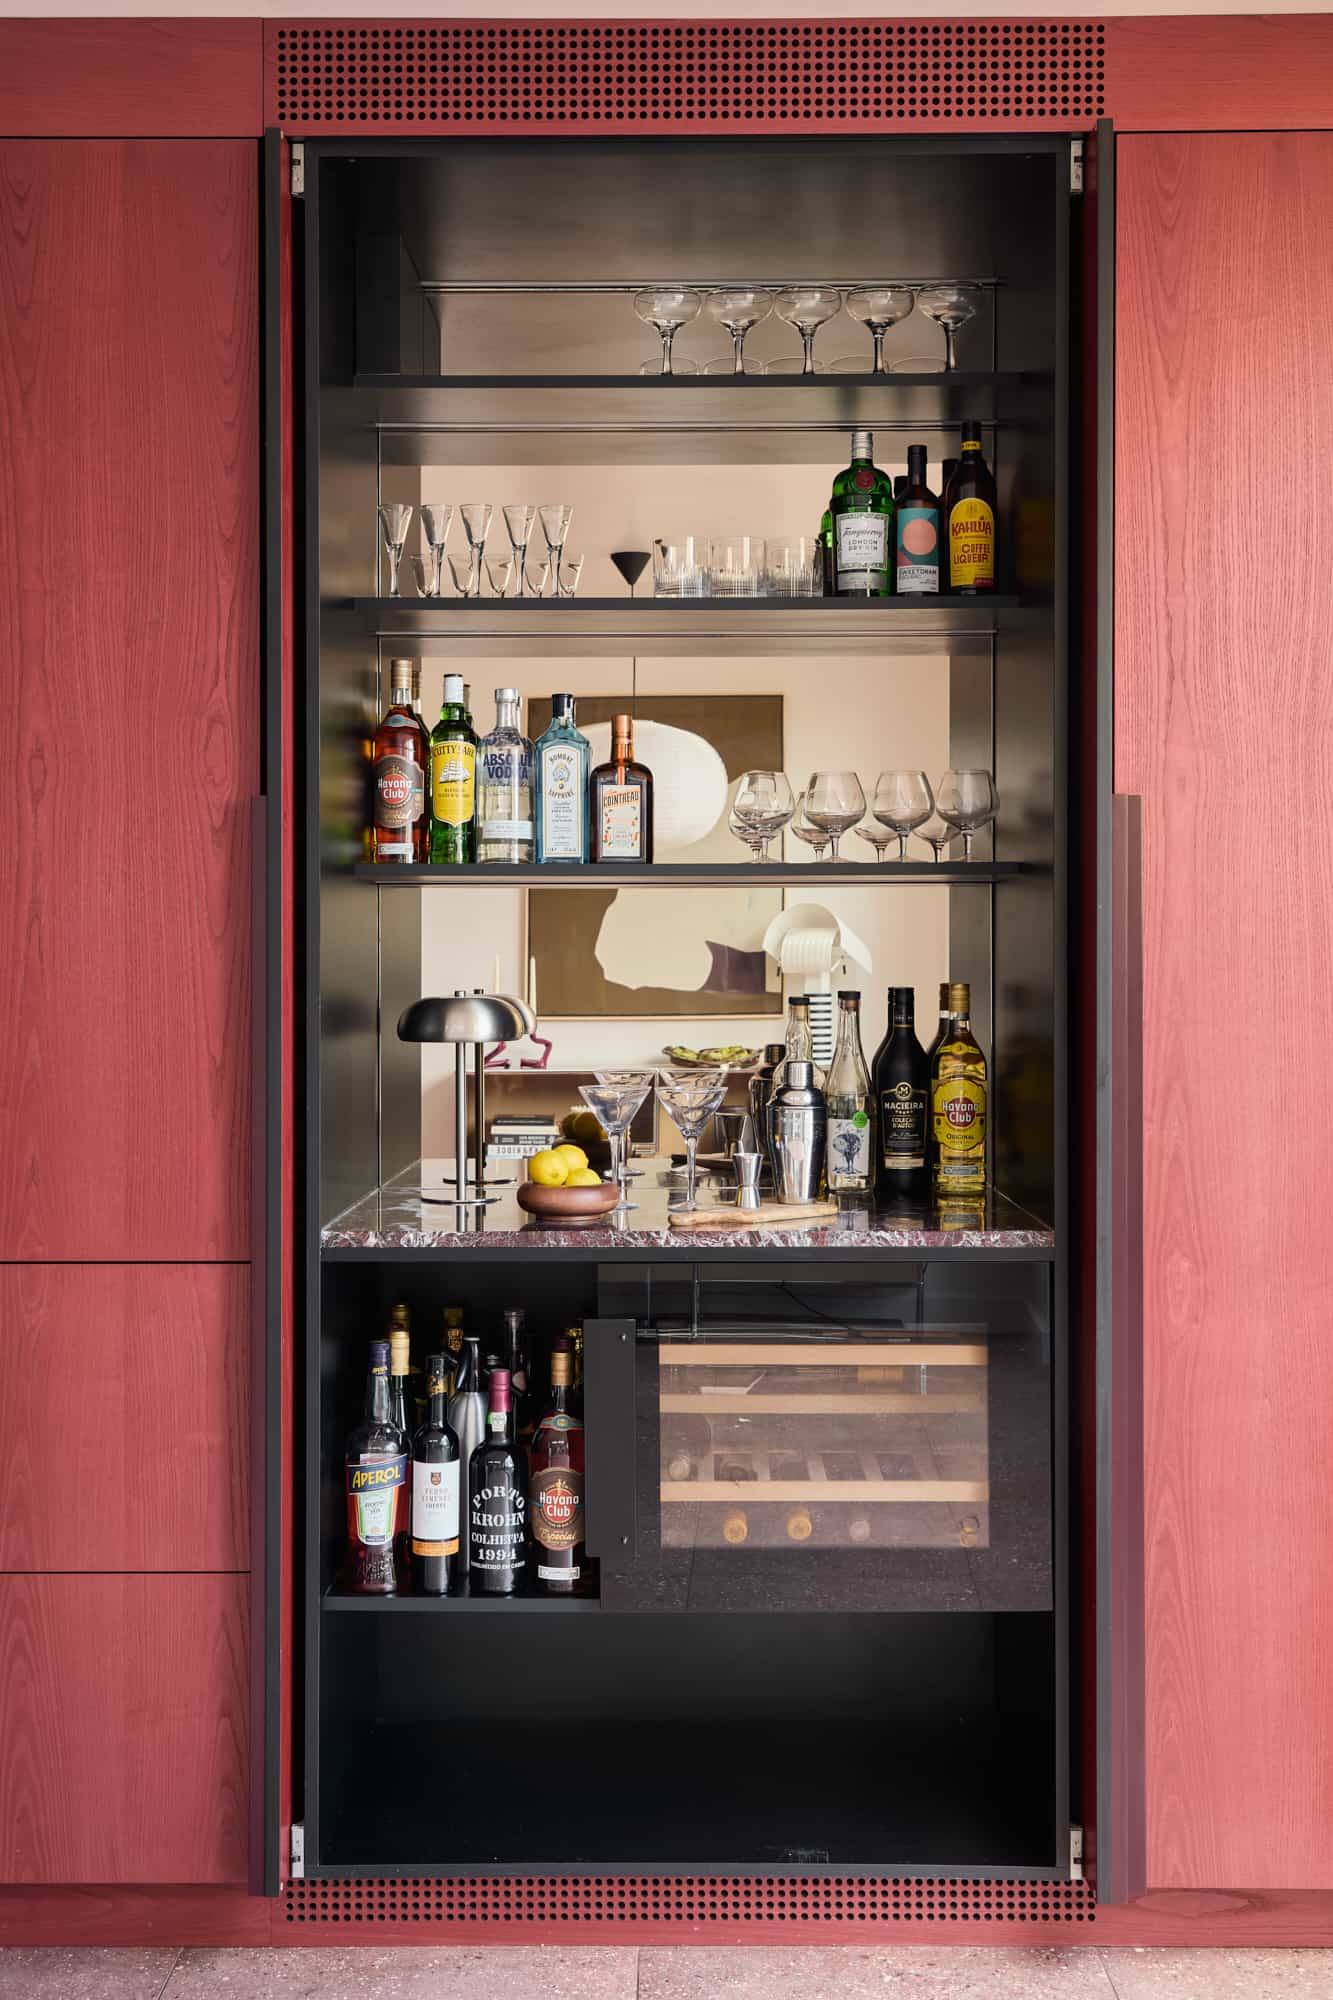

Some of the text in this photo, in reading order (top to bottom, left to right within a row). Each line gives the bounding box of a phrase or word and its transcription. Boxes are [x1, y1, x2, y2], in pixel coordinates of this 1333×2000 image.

[951, 517, 992, 536] KAHLÚA
[961, 543, 991, 554] COFFEE
[953, 553, 989, 565] LIQUEUR
[433, 744, 457, 758] CUTTY
[483, 753, 533, 767] ABSOUT
[377, 776, 413, 789] Havana
[383, 788, 405, 799] Club
[603, 791, 639, 808] COINTREAU
[884, 1101, 924, 1110] MACIEIRA
[942, 1101, 980, 1112] Havana
[949, 1111, 972, 1123] Club
[352, 1464, 401, 1489] APEROL
[472, 1486, 525, 1509] PORTO
[539, 1491, 579, 1506] Havana
[546, 1504, 571, 1518] Club
[472, 1510, 525, 1528] KROHN
[478, 1548, 517, 1561] 1994
